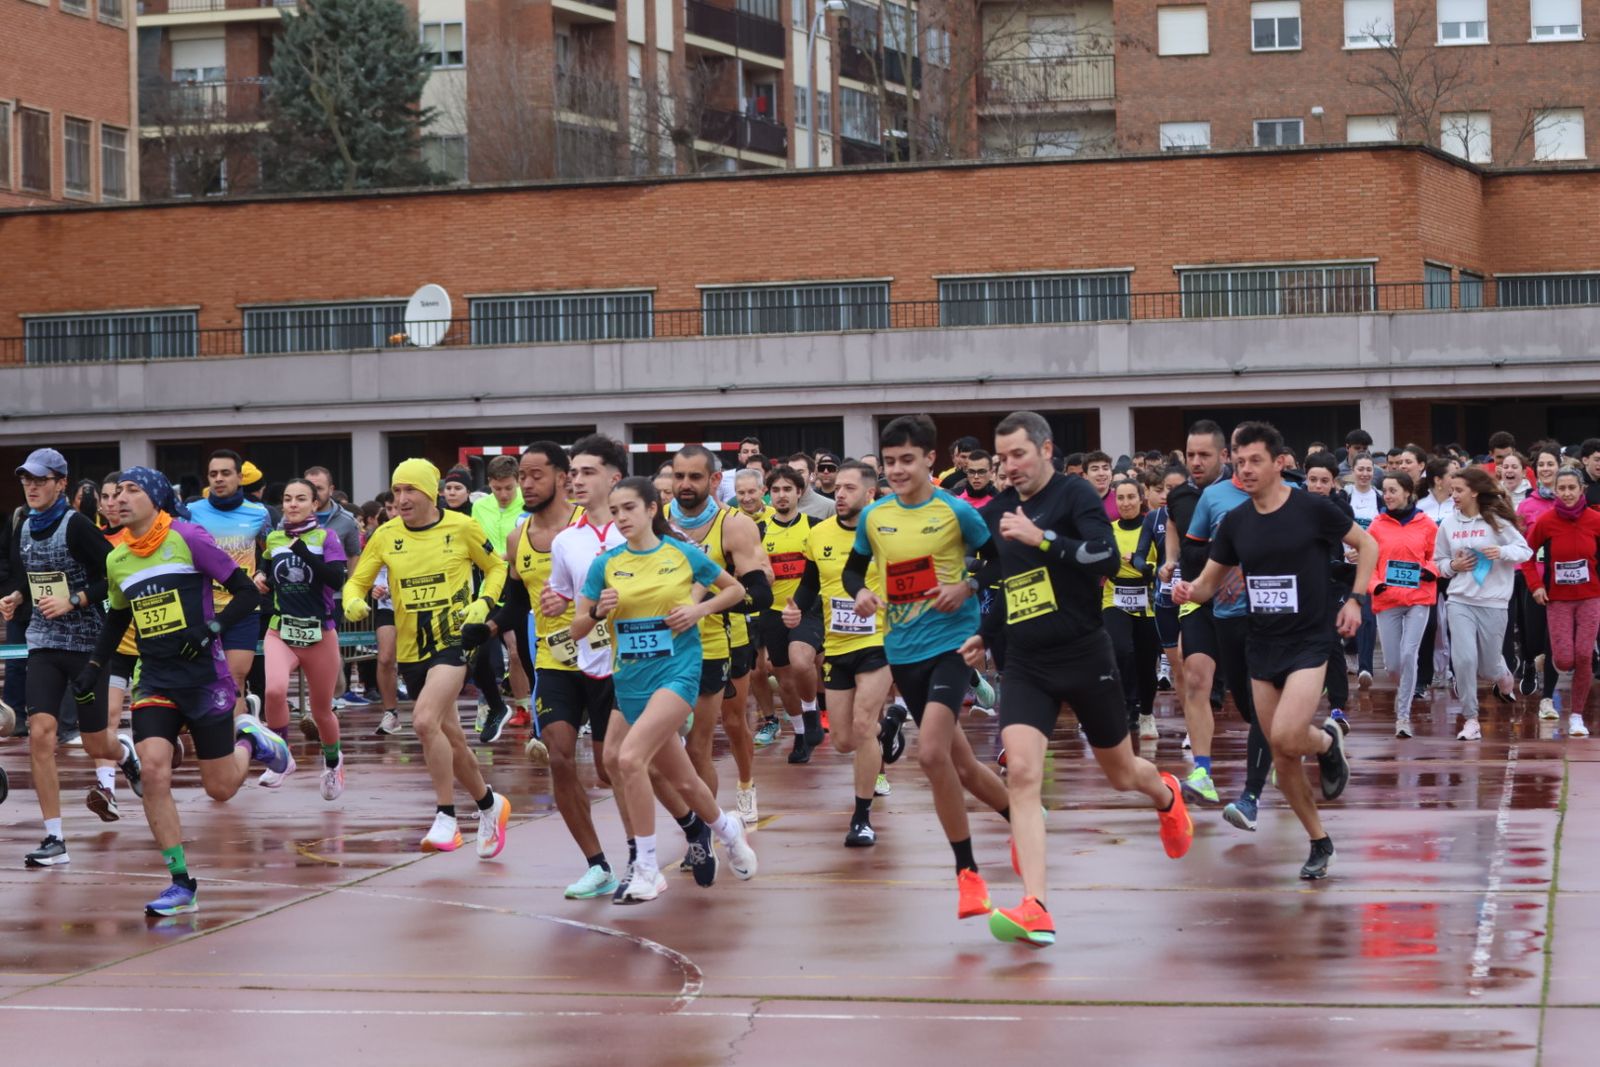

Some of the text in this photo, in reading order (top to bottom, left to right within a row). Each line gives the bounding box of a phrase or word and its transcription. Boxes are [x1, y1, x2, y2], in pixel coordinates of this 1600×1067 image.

[782, 562, 796, 573] 84
[1394, 569, 1413, 580] 152
[895, 576, 915, 592] 87
[38, 585, 53, 596] 78
[411, 586, 437, 601] 177
[1121, 596, 1138, 605] 401
[1255, 591, 1288, 604] 1279
[143, 608, 167, 625] 337
[287, 628, 315, 640] 1322
[629, 634, 658, 649] 153
